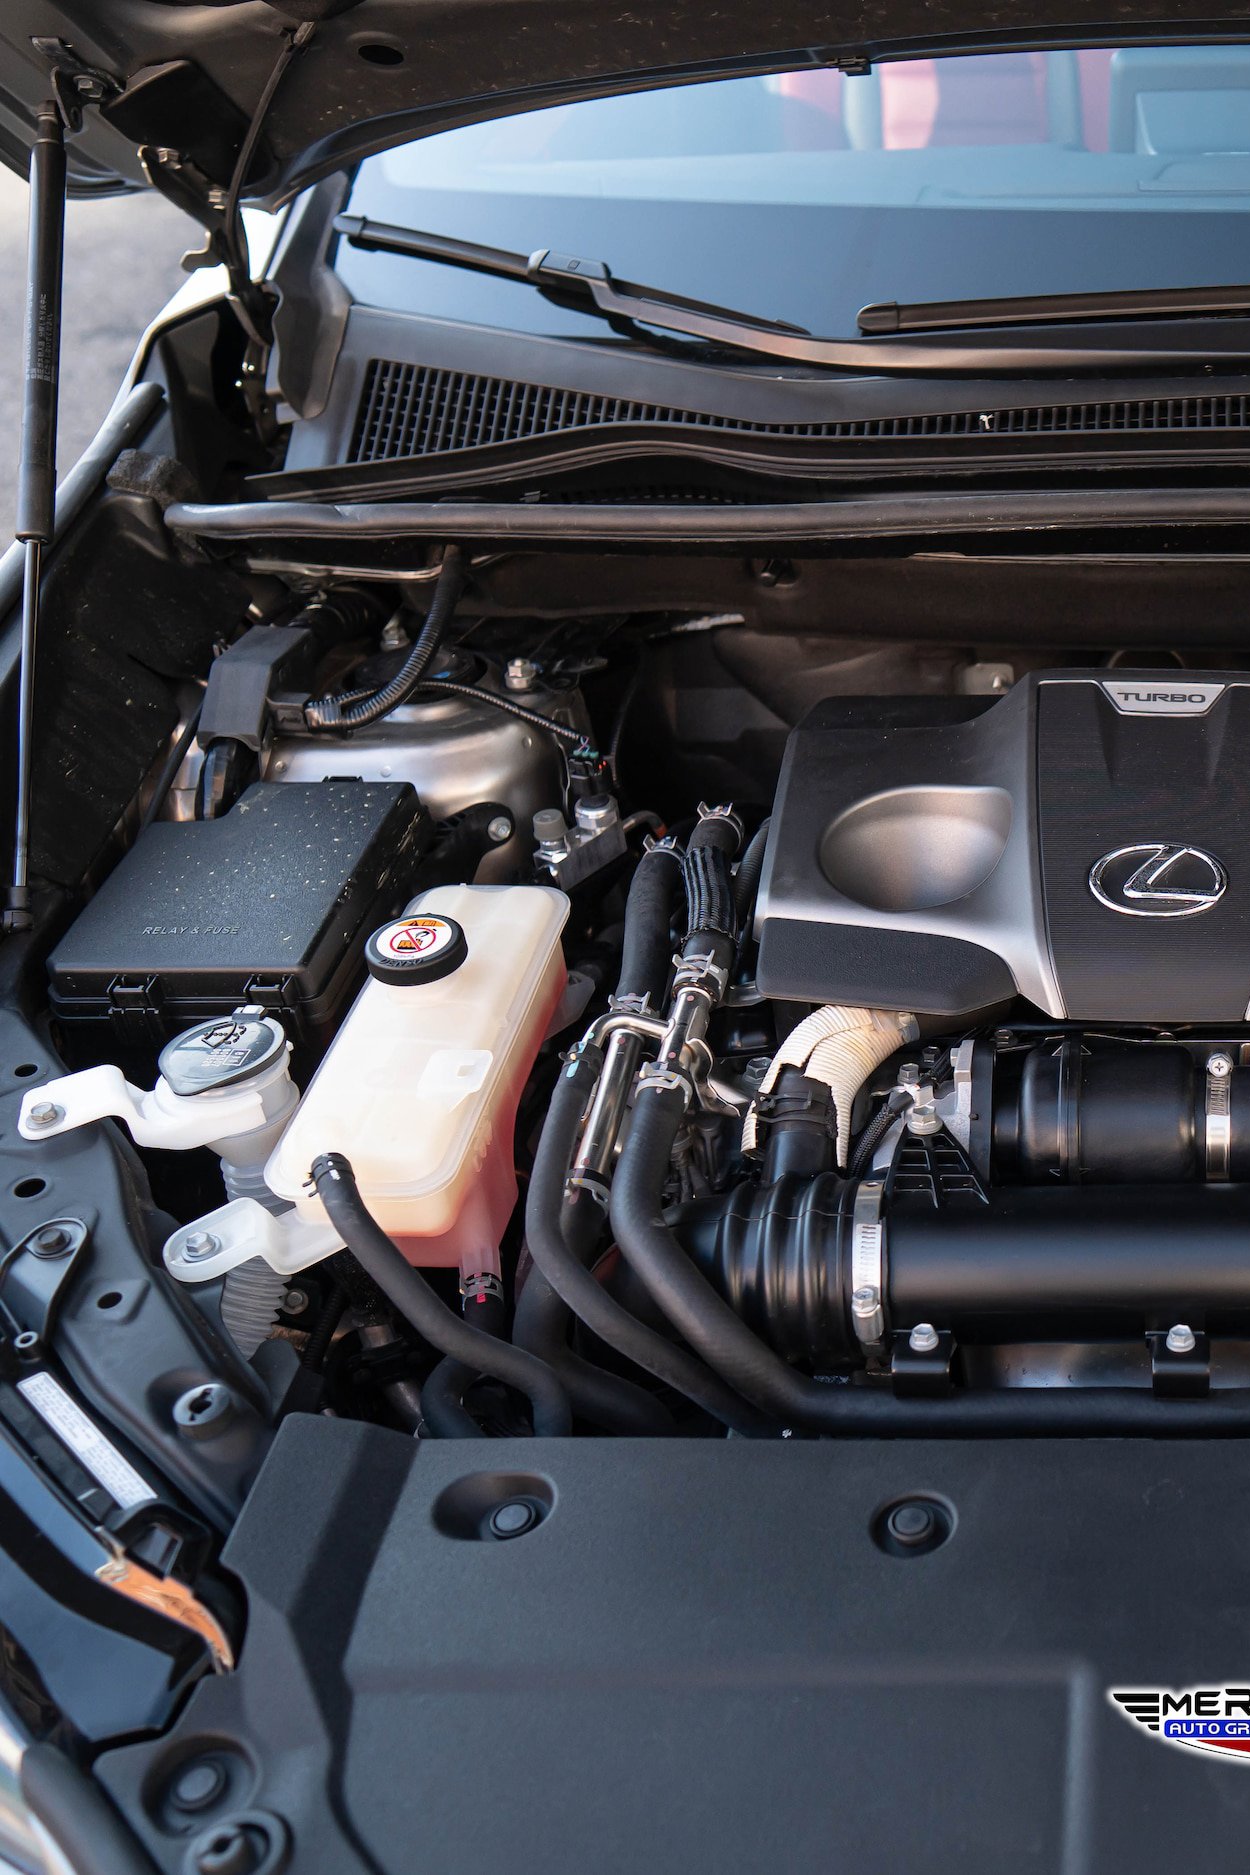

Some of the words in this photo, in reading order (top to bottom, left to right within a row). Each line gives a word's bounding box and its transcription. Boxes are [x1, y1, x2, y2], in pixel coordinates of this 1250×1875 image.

[1117, 692, 1206, 703] TURBO
[142, 926, 189, 935] RELAY
[190, 926, 200, 935] &
[203, 926, 241, 935] FUSE
